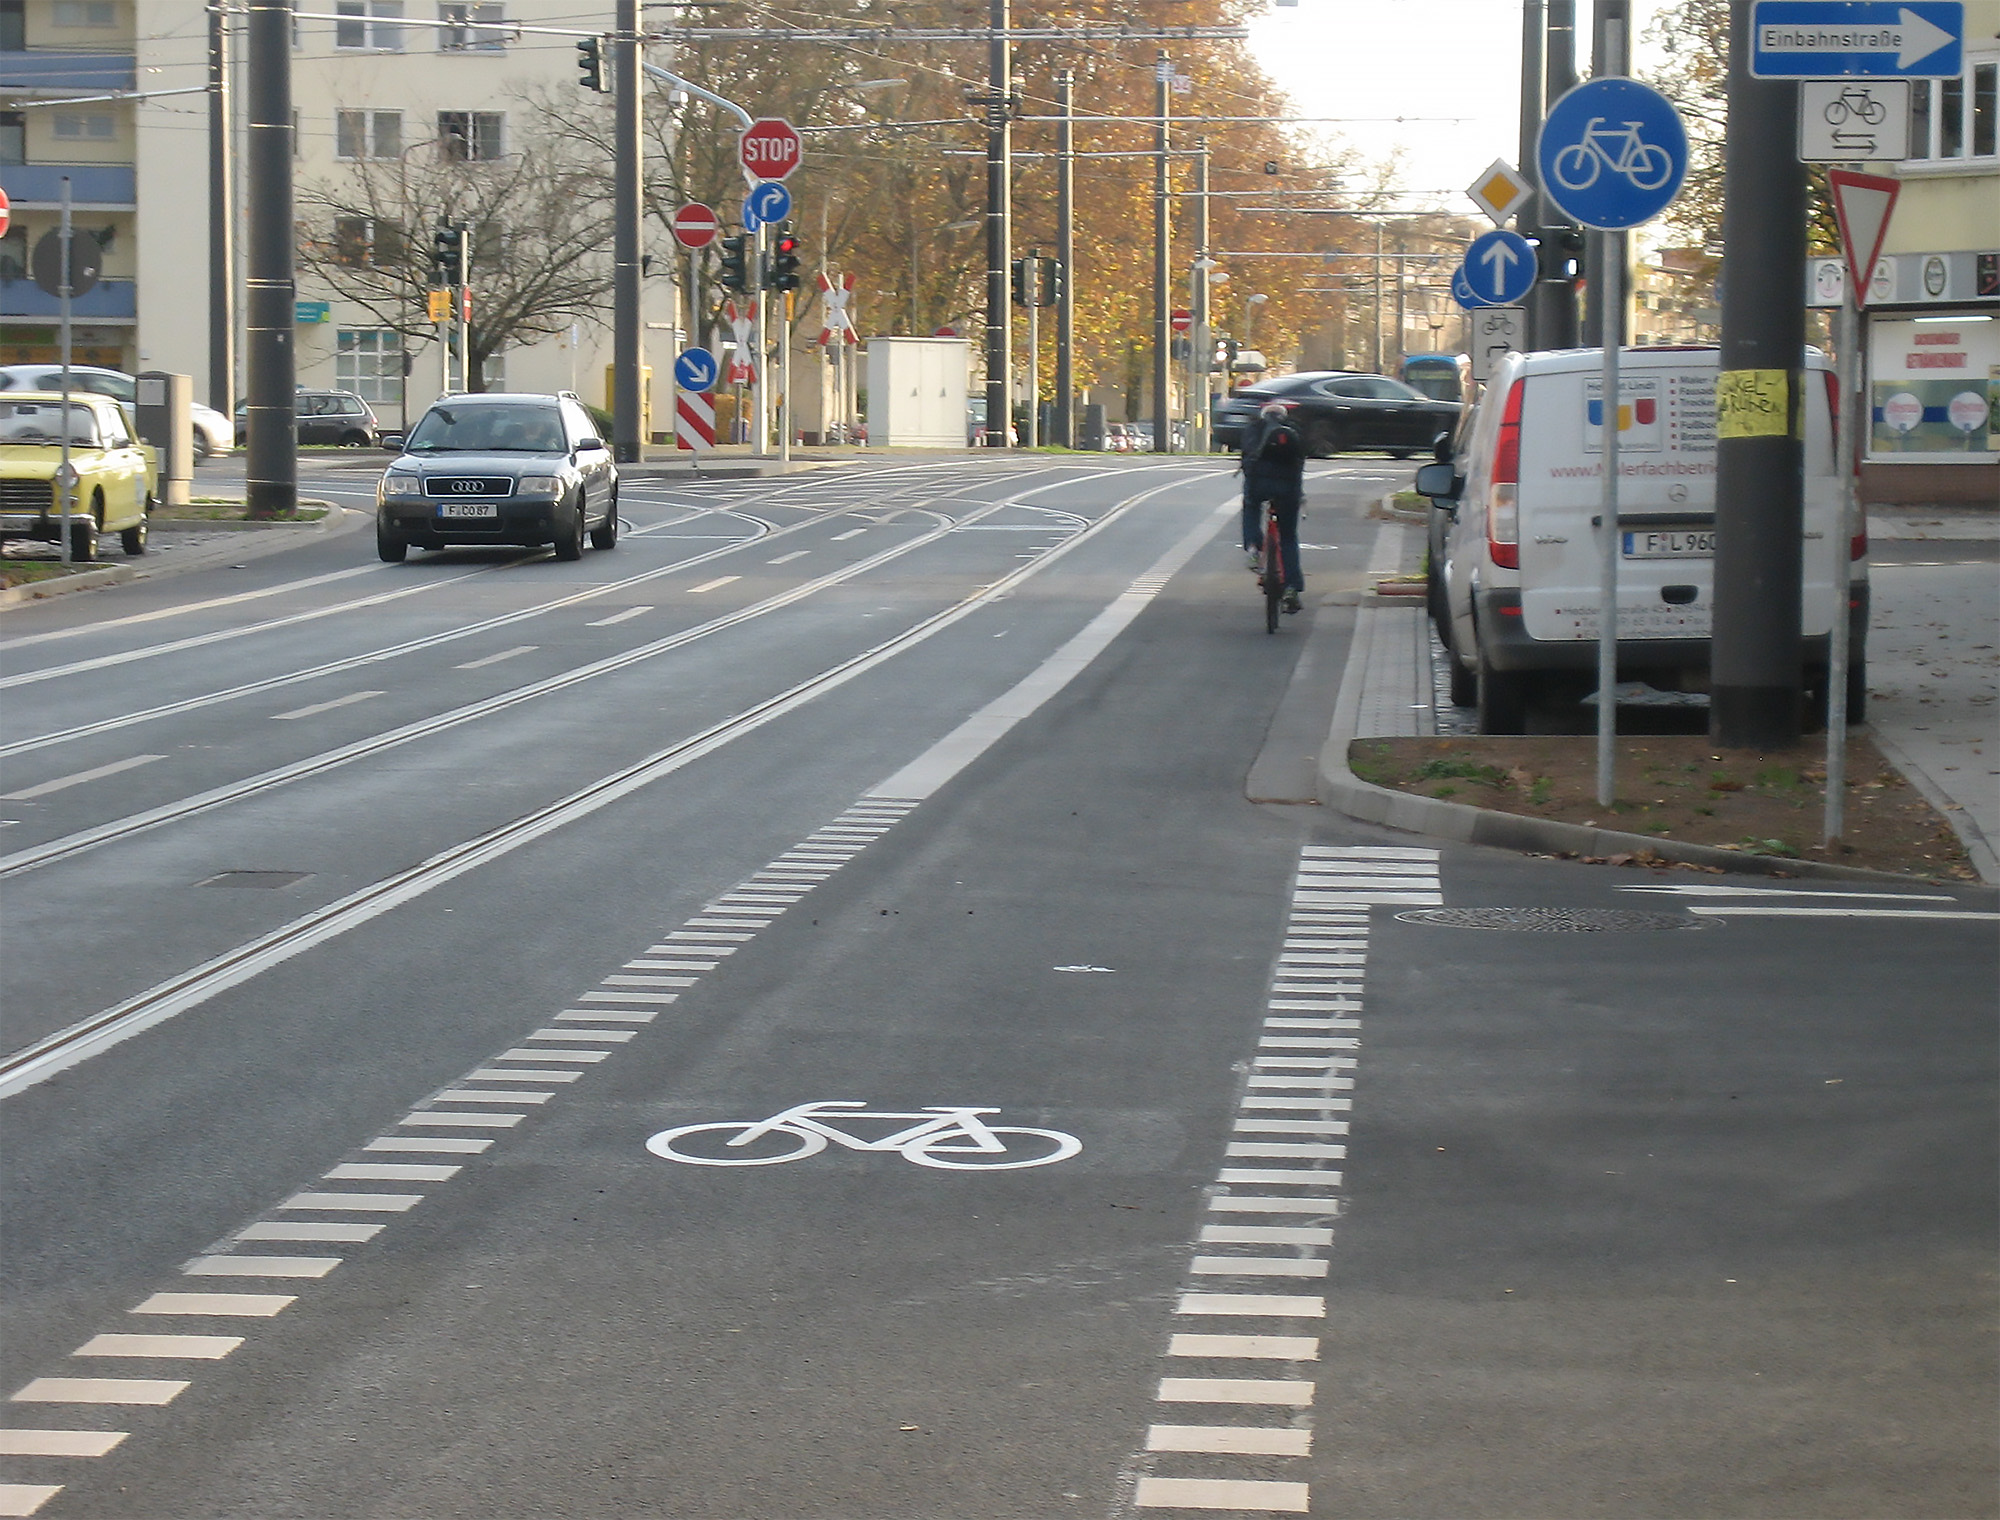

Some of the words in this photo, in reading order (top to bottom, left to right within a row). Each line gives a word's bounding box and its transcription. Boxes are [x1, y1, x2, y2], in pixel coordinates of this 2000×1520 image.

[1764, 30, 1902, 47] Einbahnstraße
[744, 137, 796, 162] STOP
[1648, 534, 1658, 551] F
[1671, 534, 1682, 551] L
